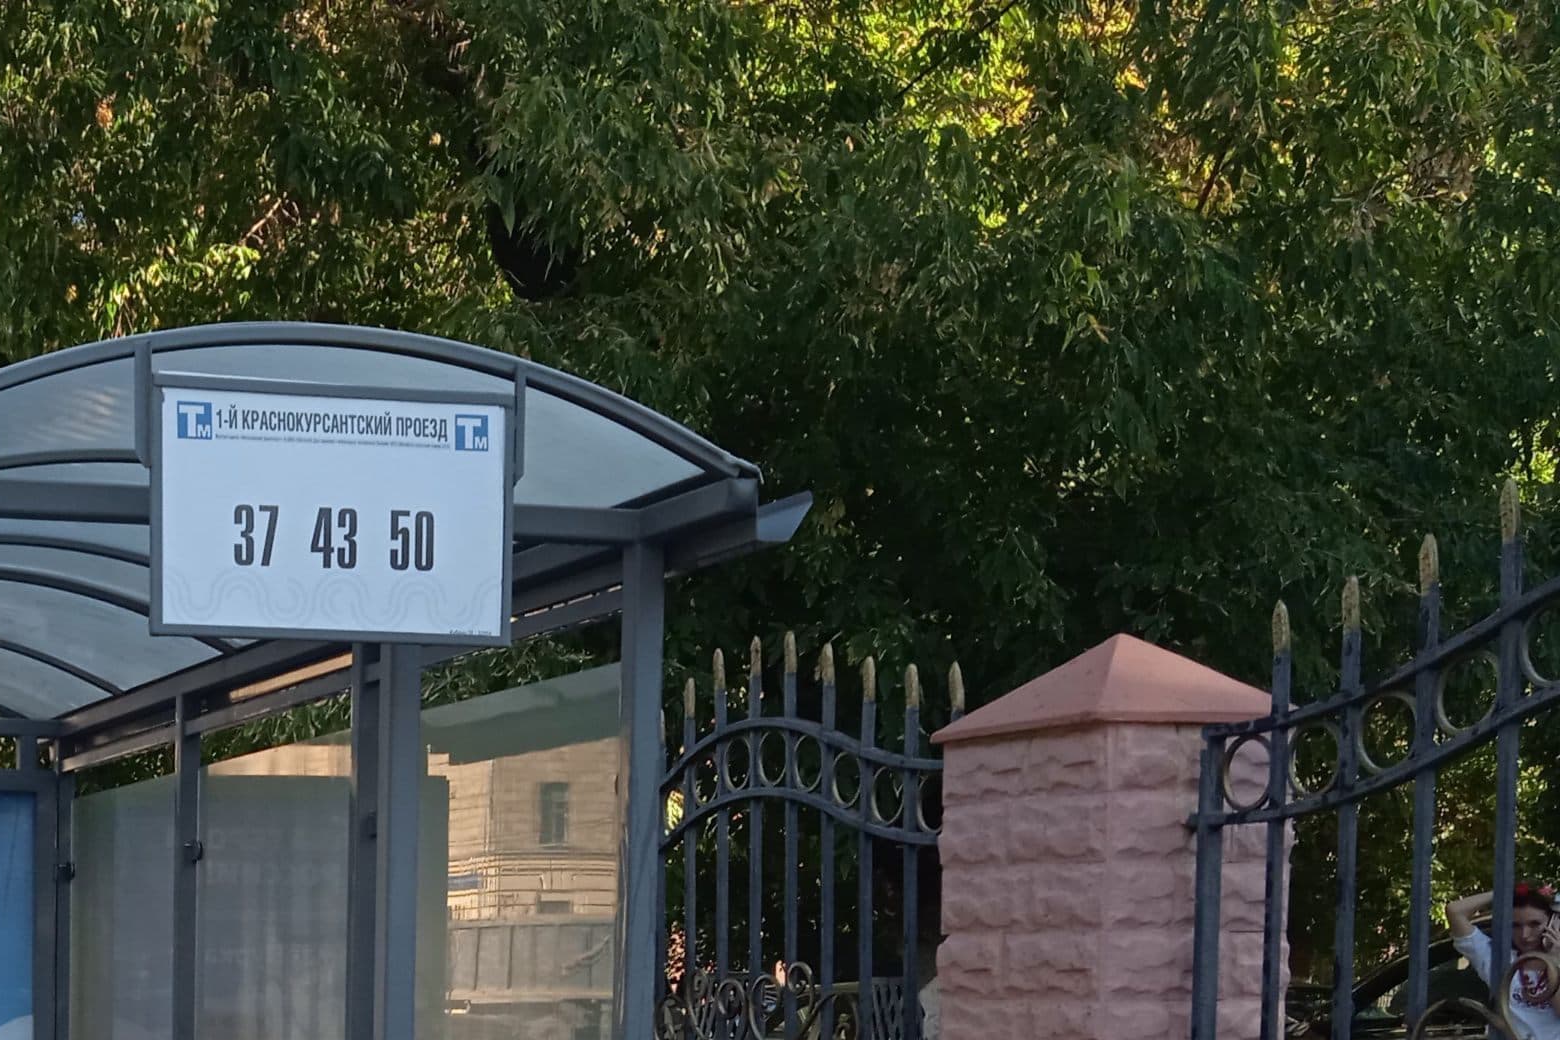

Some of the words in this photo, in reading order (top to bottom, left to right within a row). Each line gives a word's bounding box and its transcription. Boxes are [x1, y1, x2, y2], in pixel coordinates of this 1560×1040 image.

[216, 404, 238, 430] 1-Й
[242, 408, 392, 436] КРАСНОКУРСАНТСКИЙ
[396, 416, 448, 442] ПРОЕЗД
[234, 504, 279, 566] 37
[310, 507, 358, 569] 43
[390, 510, 434, 571] 50
